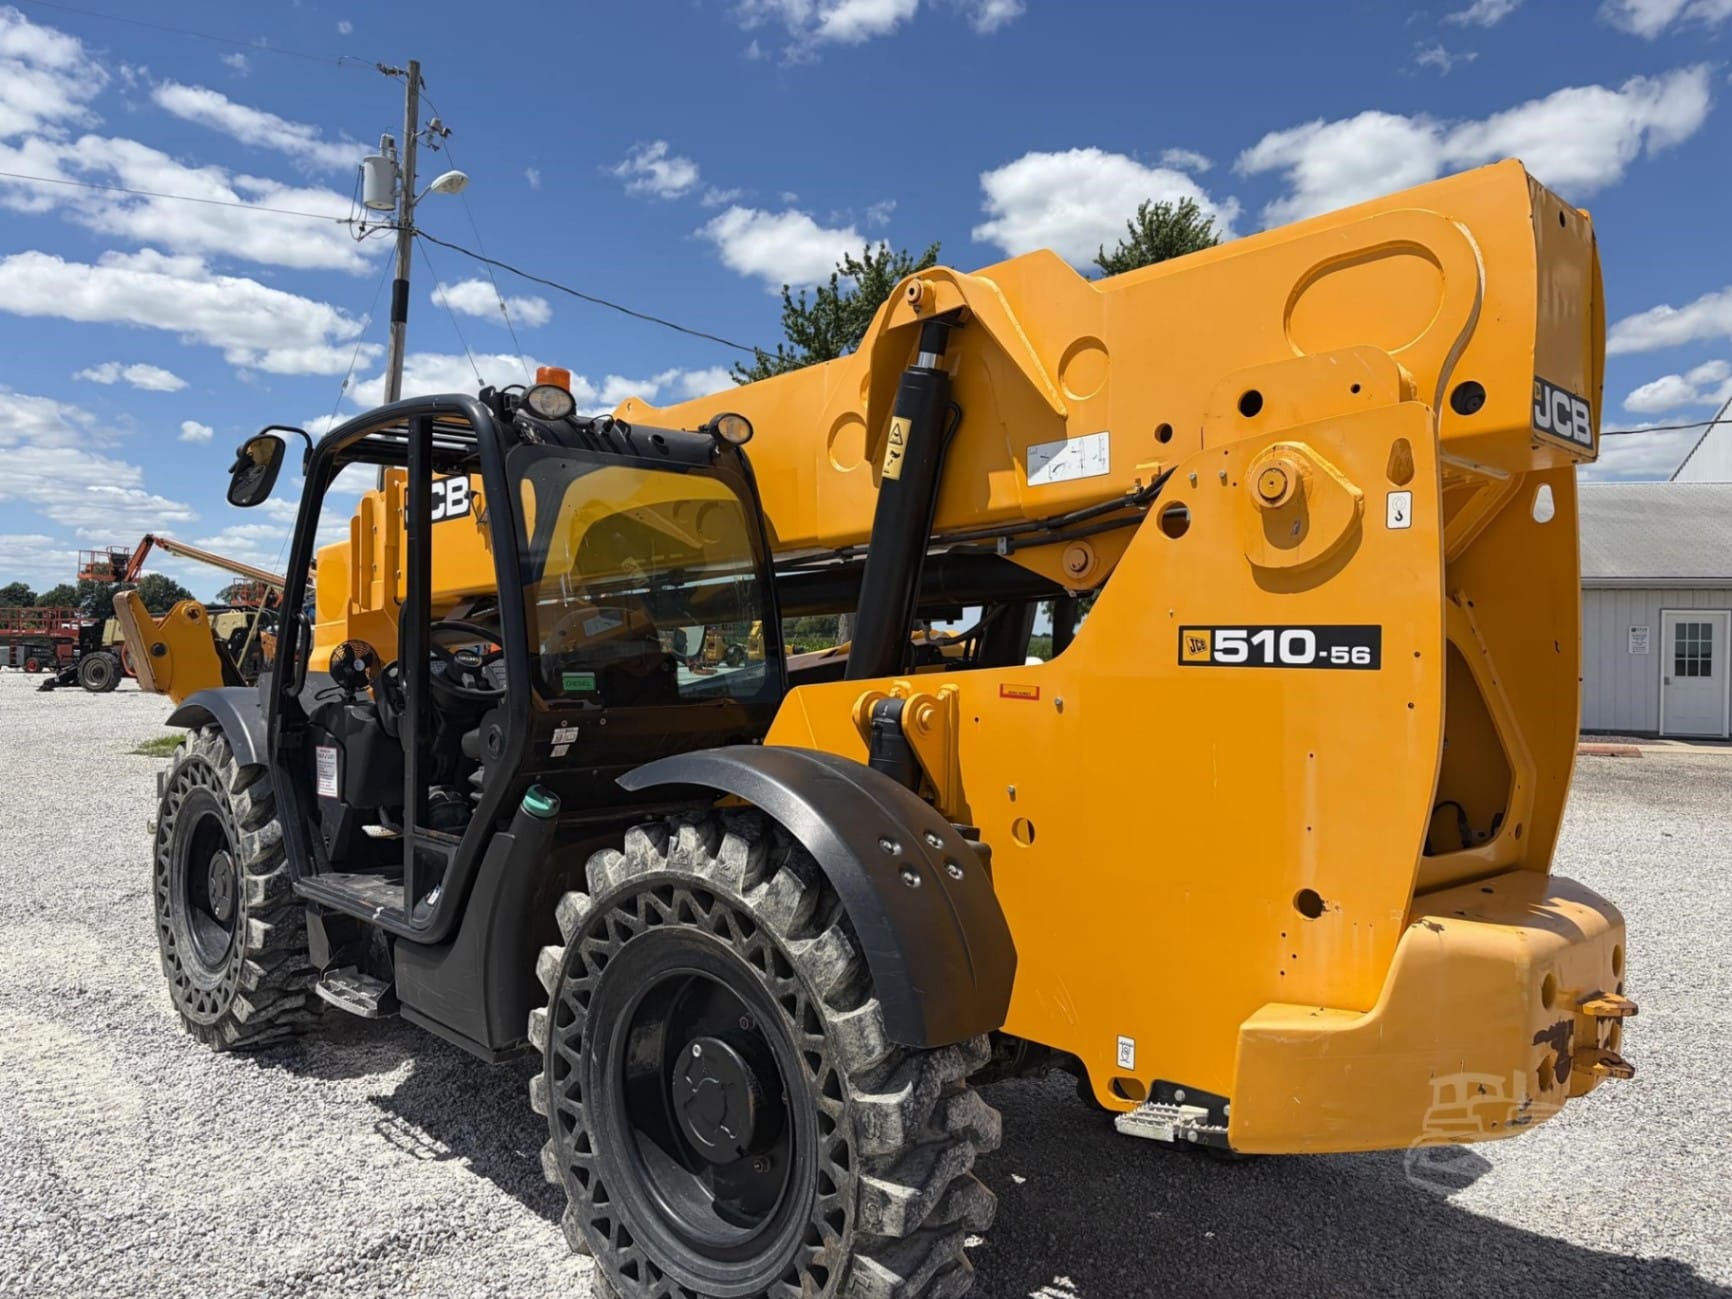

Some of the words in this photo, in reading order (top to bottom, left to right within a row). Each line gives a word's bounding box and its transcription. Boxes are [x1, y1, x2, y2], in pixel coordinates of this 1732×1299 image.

[1534, 385, 1592, 445] JCB
[406, 476, 470, 523] CB
[1189, 637, 1208, 654] JCB
[1213, 629, 1371, 665] 510-56
